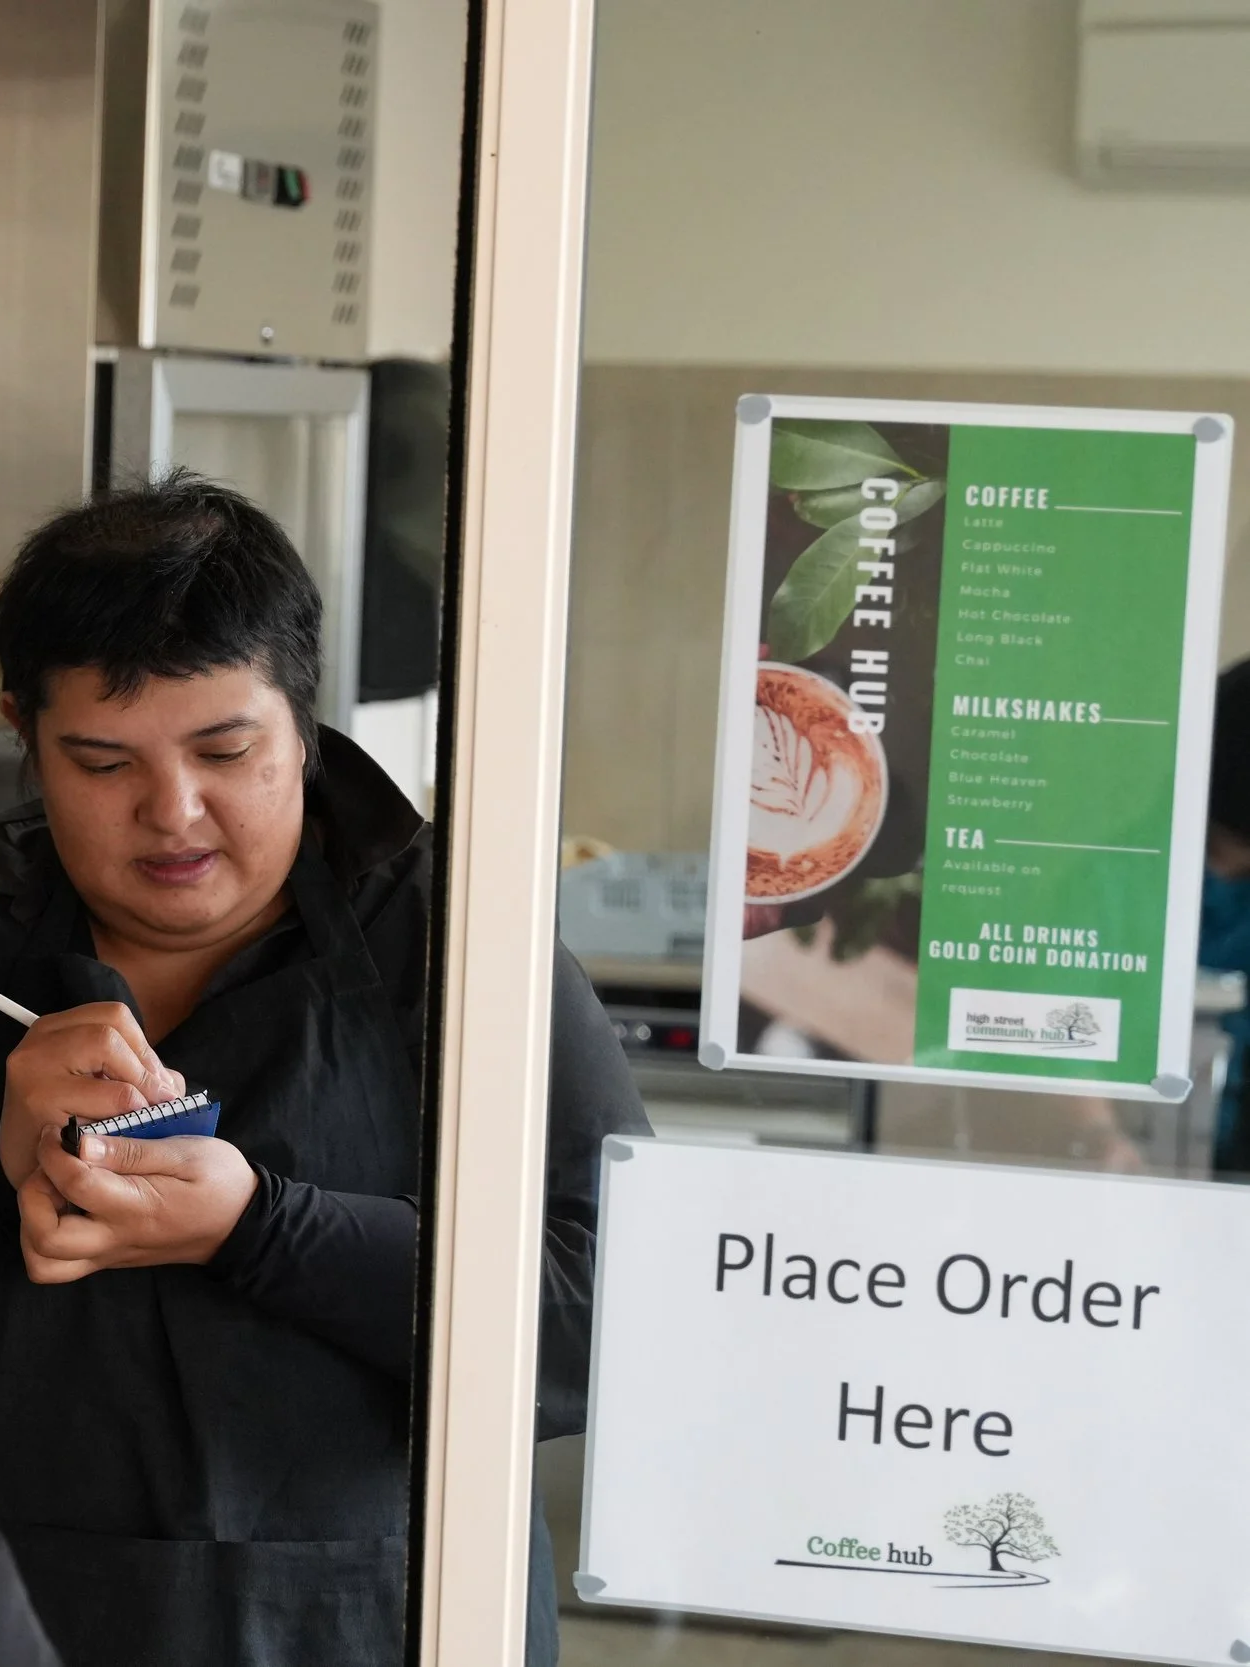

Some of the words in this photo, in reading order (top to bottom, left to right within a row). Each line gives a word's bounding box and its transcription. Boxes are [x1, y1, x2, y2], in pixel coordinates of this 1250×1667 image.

[965, 485, 1049, 510] COFFEE
[963, 516, 1004, 528] Latte
[853, 477, 899, 629] COFFEE
[962, 539, 1056, 554] Cappuccino
[960, 561, 991, 574] Flat
[996, 563, 1043, 576] White
[959, 584, 1011, 598] Mocha
[958, 609, 986, 620] Hot
[991, 610, 1071, 624] Chocolate
[956, 631, 994, 647] Long
[1000, 633, 1043, 646] Black
[954, 654, 990, 665] Chai
[848, 650, 889, 734] HUB
[953, 695, 1101, 723] MILKSHAKES
[951, 726, 1016, 739] Caramel
[950, 749, 1029, 763] Chocolate
[948, 771, 983, 784] Blue
[989, 775, 1047, 788] Heaven
[948, 794, 1034, 812] Strawberry
[945, 827, 985, 849] TEA
[943, 859, 1016, 874] Available
[1021, 865, 1041, 876] on
[942, 883, 1001, 897] request
[979, 922, 1014, 942] ALL
[1023, 925, 1098, 947] DRINKS
[929, 940, 981, 961] GOLD
[988, 944, 1038, 965] COIN
[1046, 948, 1148, 972] DONATION
[966, 1012, 990, 1026] high
[994, 1014, 1025, 1026] street
[966, 1025, 1036, 1041] community
[1041, 1027, 1065, 1041] hub
[715, 1232, 906, 1308] Place
[936, 1253, 1160, 1330] Order
[837, 1381, 1014, 1457] Here
[806, 1536, 882, 1561] Coffee
[886, 1542, 933, 1567] hub
